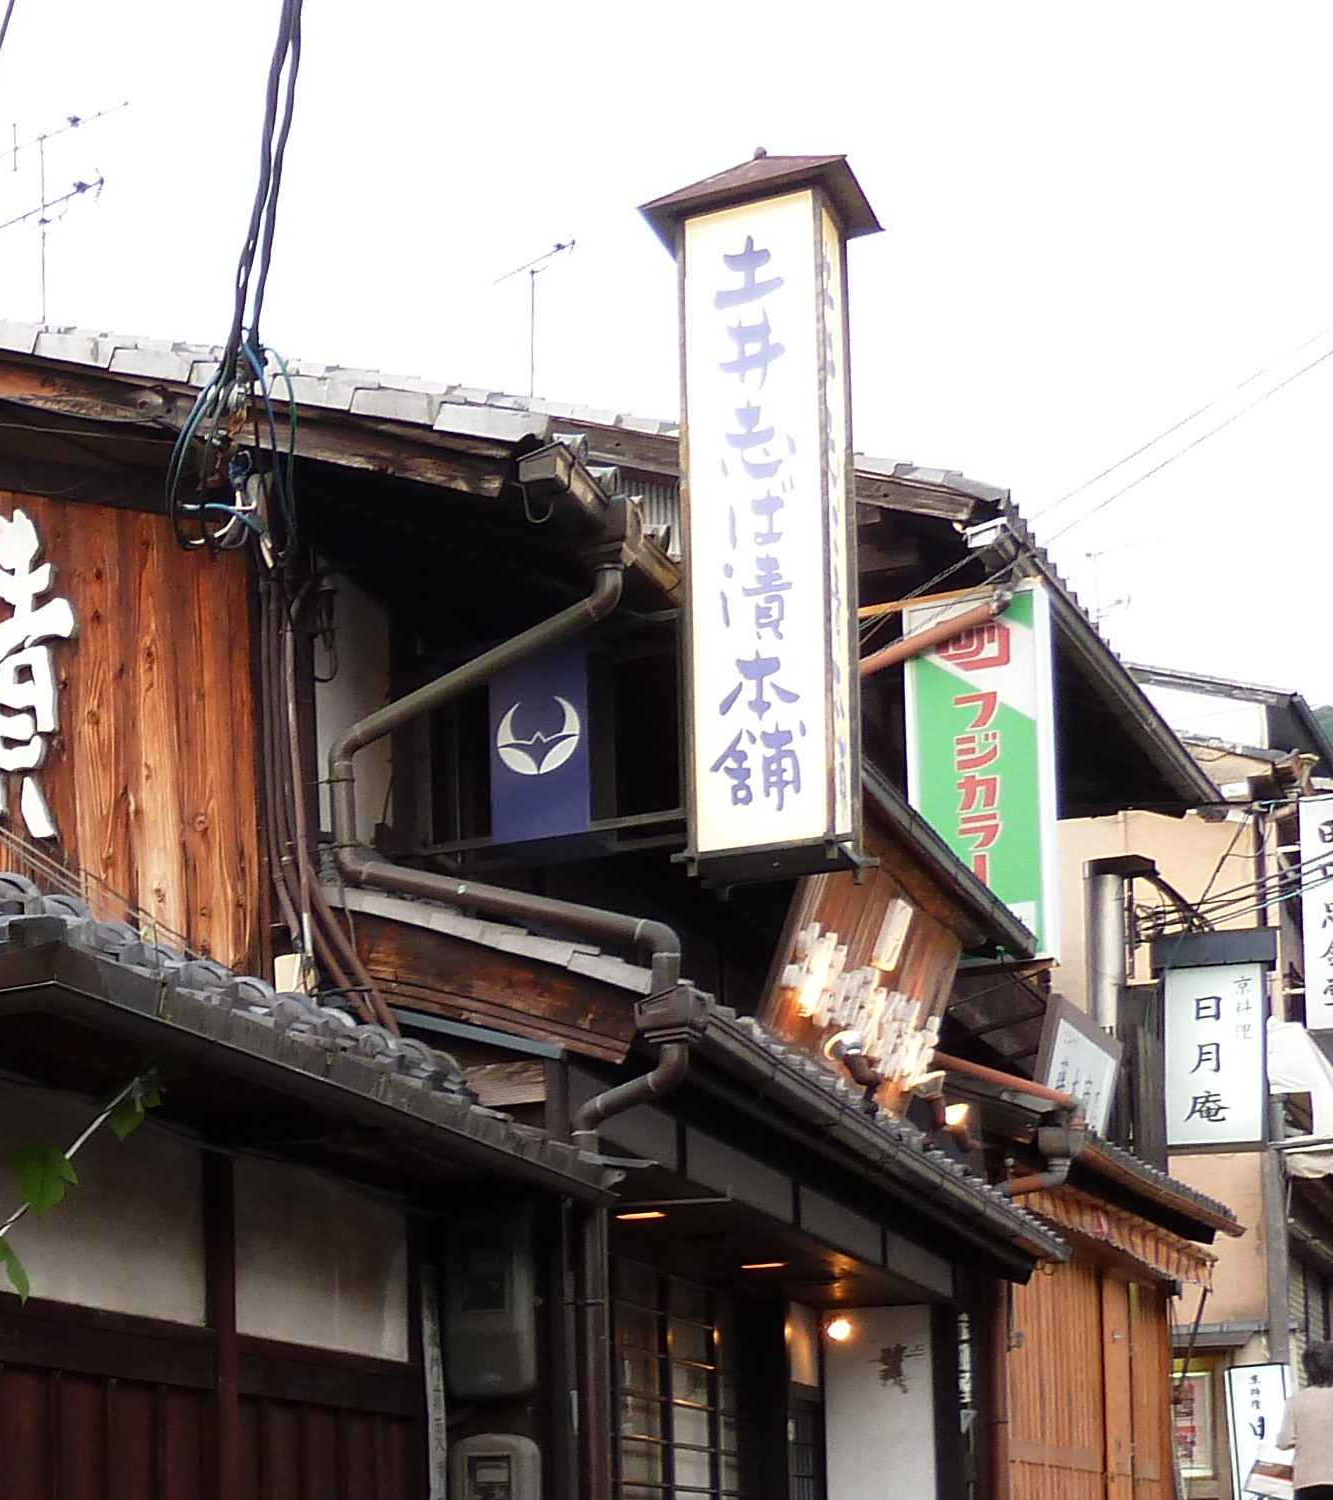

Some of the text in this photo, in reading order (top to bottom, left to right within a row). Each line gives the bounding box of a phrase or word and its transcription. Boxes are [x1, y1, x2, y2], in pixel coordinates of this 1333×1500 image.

[713, 236, 806, 811] 土井志ば漬本舗
[953, 691, 1001, 888] フジカラー
[1184, 996, 1231, 1122] 日月庵
[1234, 975, 1253, 1040] 京料理
